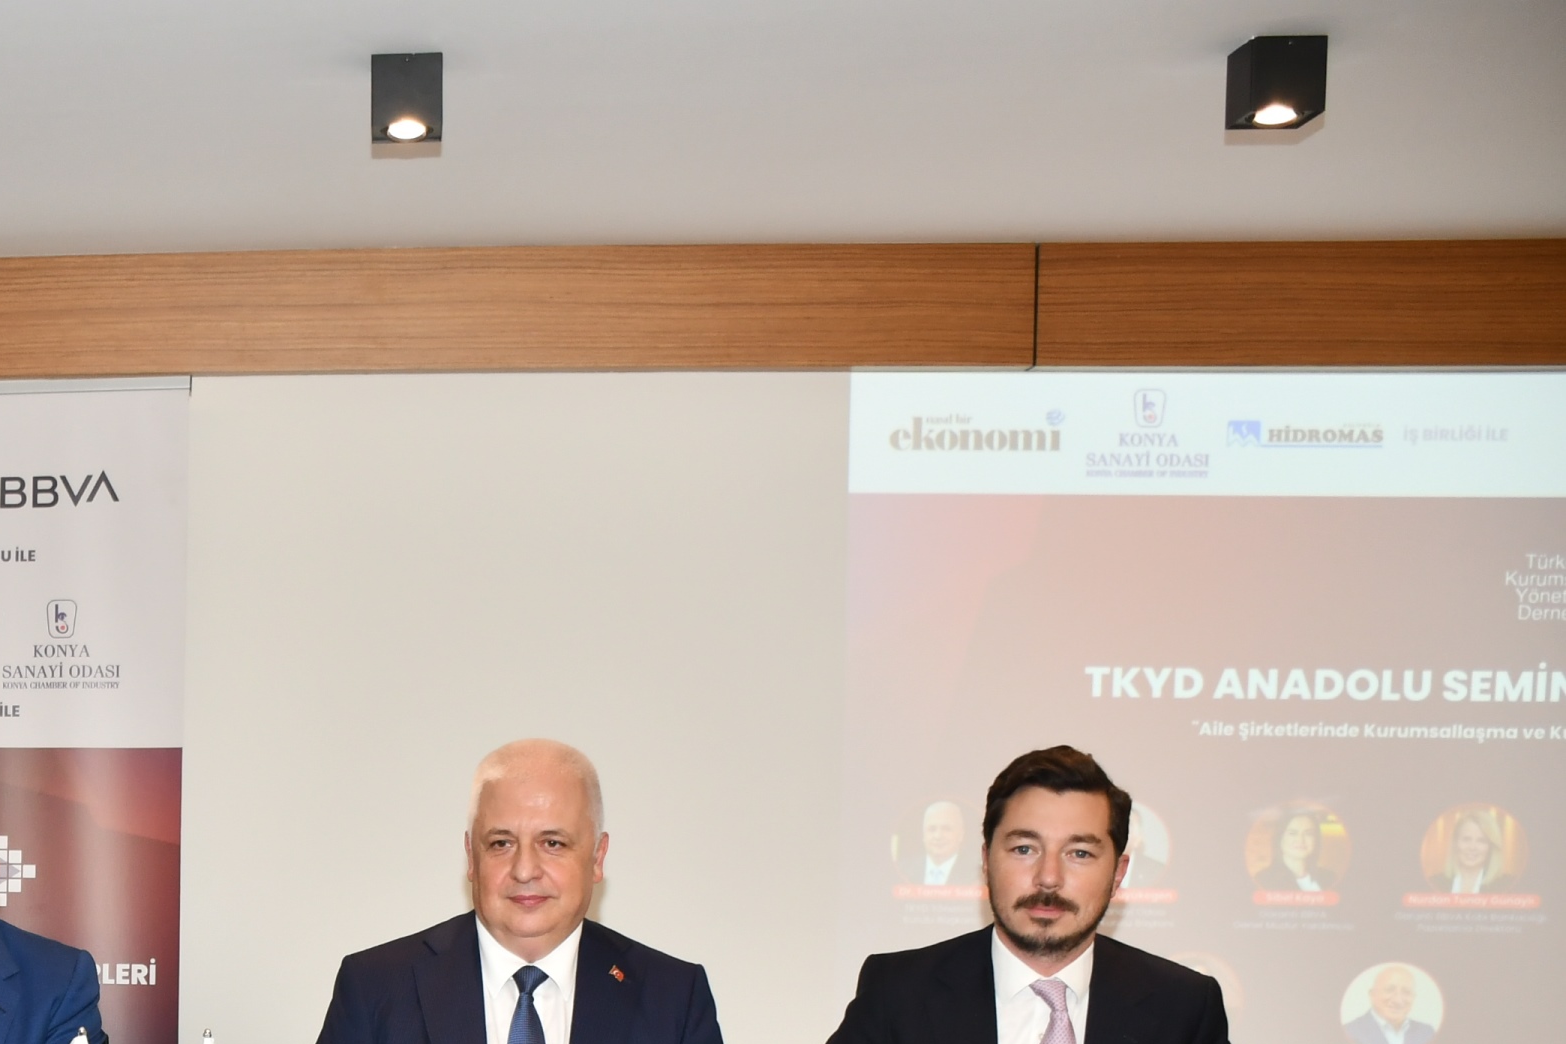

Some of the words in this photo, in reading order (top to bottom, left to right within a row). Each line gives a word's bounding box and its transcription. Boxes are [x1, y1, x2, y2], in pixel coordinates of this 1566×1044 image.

[889, 415, 1061, 452] ekonomi
[1119, 433, 1179, 447] KONYA
[1268, 425, 1384, 443] HİDROMAS
[1403, 425, 1418, 445] İŞ
[1423, 424, 1482, 442] BİRLİĞİ
[1487, 425, 1509, 442] İLE
[1086, 450, 1151, 467] SANAYİ
[1156, 453, 1210, 467] ODASI
[0, 470, 120, 509] BBVA
[15, 546, 36, 563] İLE
[33, 644, 90, 658] KONYA
[2, 662, 63, 679] SANAYİ
[69, 664, 120, 679] ODASI
[2, 681, 28, 689] KONYA
[30, 681, 67, 689] CHAMBER
[69, 681, 79, 689] OF
[82, 681, 120, 689] INDUSTRY
[1085, 665, 1203, 699] TKYD
[1213, 667, 1432, 702] ANADOLU
[0, 703, 20, 718] İLE
[1238, 721, 1359, 743] Şirketlerinde
[1364, 723, 1517, 745] Kurumsallaşma
[1522, 727, 1545, 740] ve
